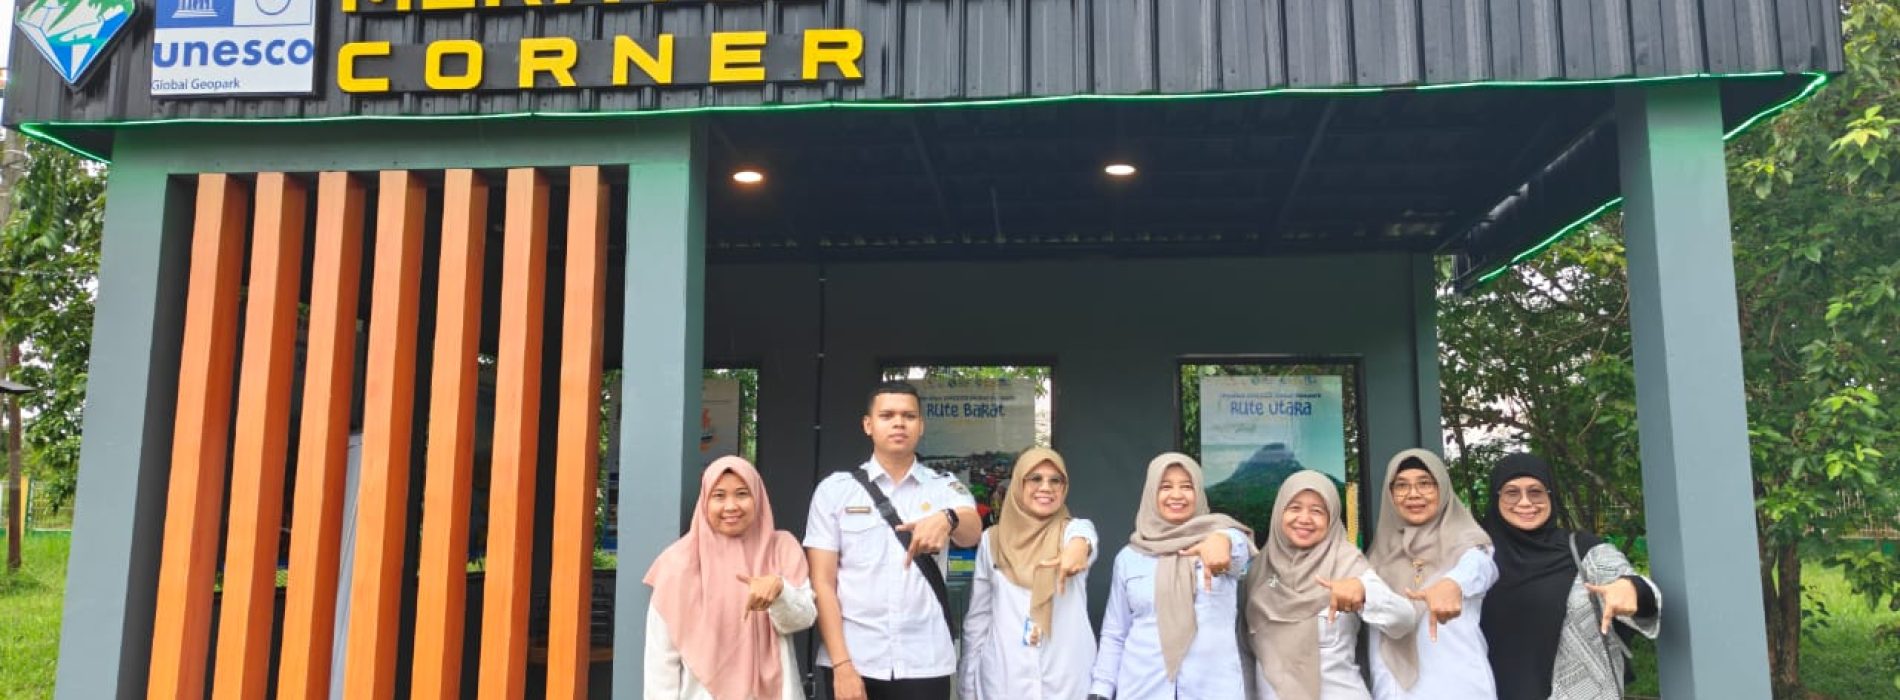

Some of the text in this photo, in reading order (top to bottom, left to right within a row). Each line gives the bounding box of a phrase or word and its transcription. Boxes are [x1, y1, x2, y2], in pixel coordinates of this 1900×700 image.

[153, 38, 314, 67] unesco
[337, 28, 863, 92] CORNER
[151, 77, 240, 92] Global Geopark
